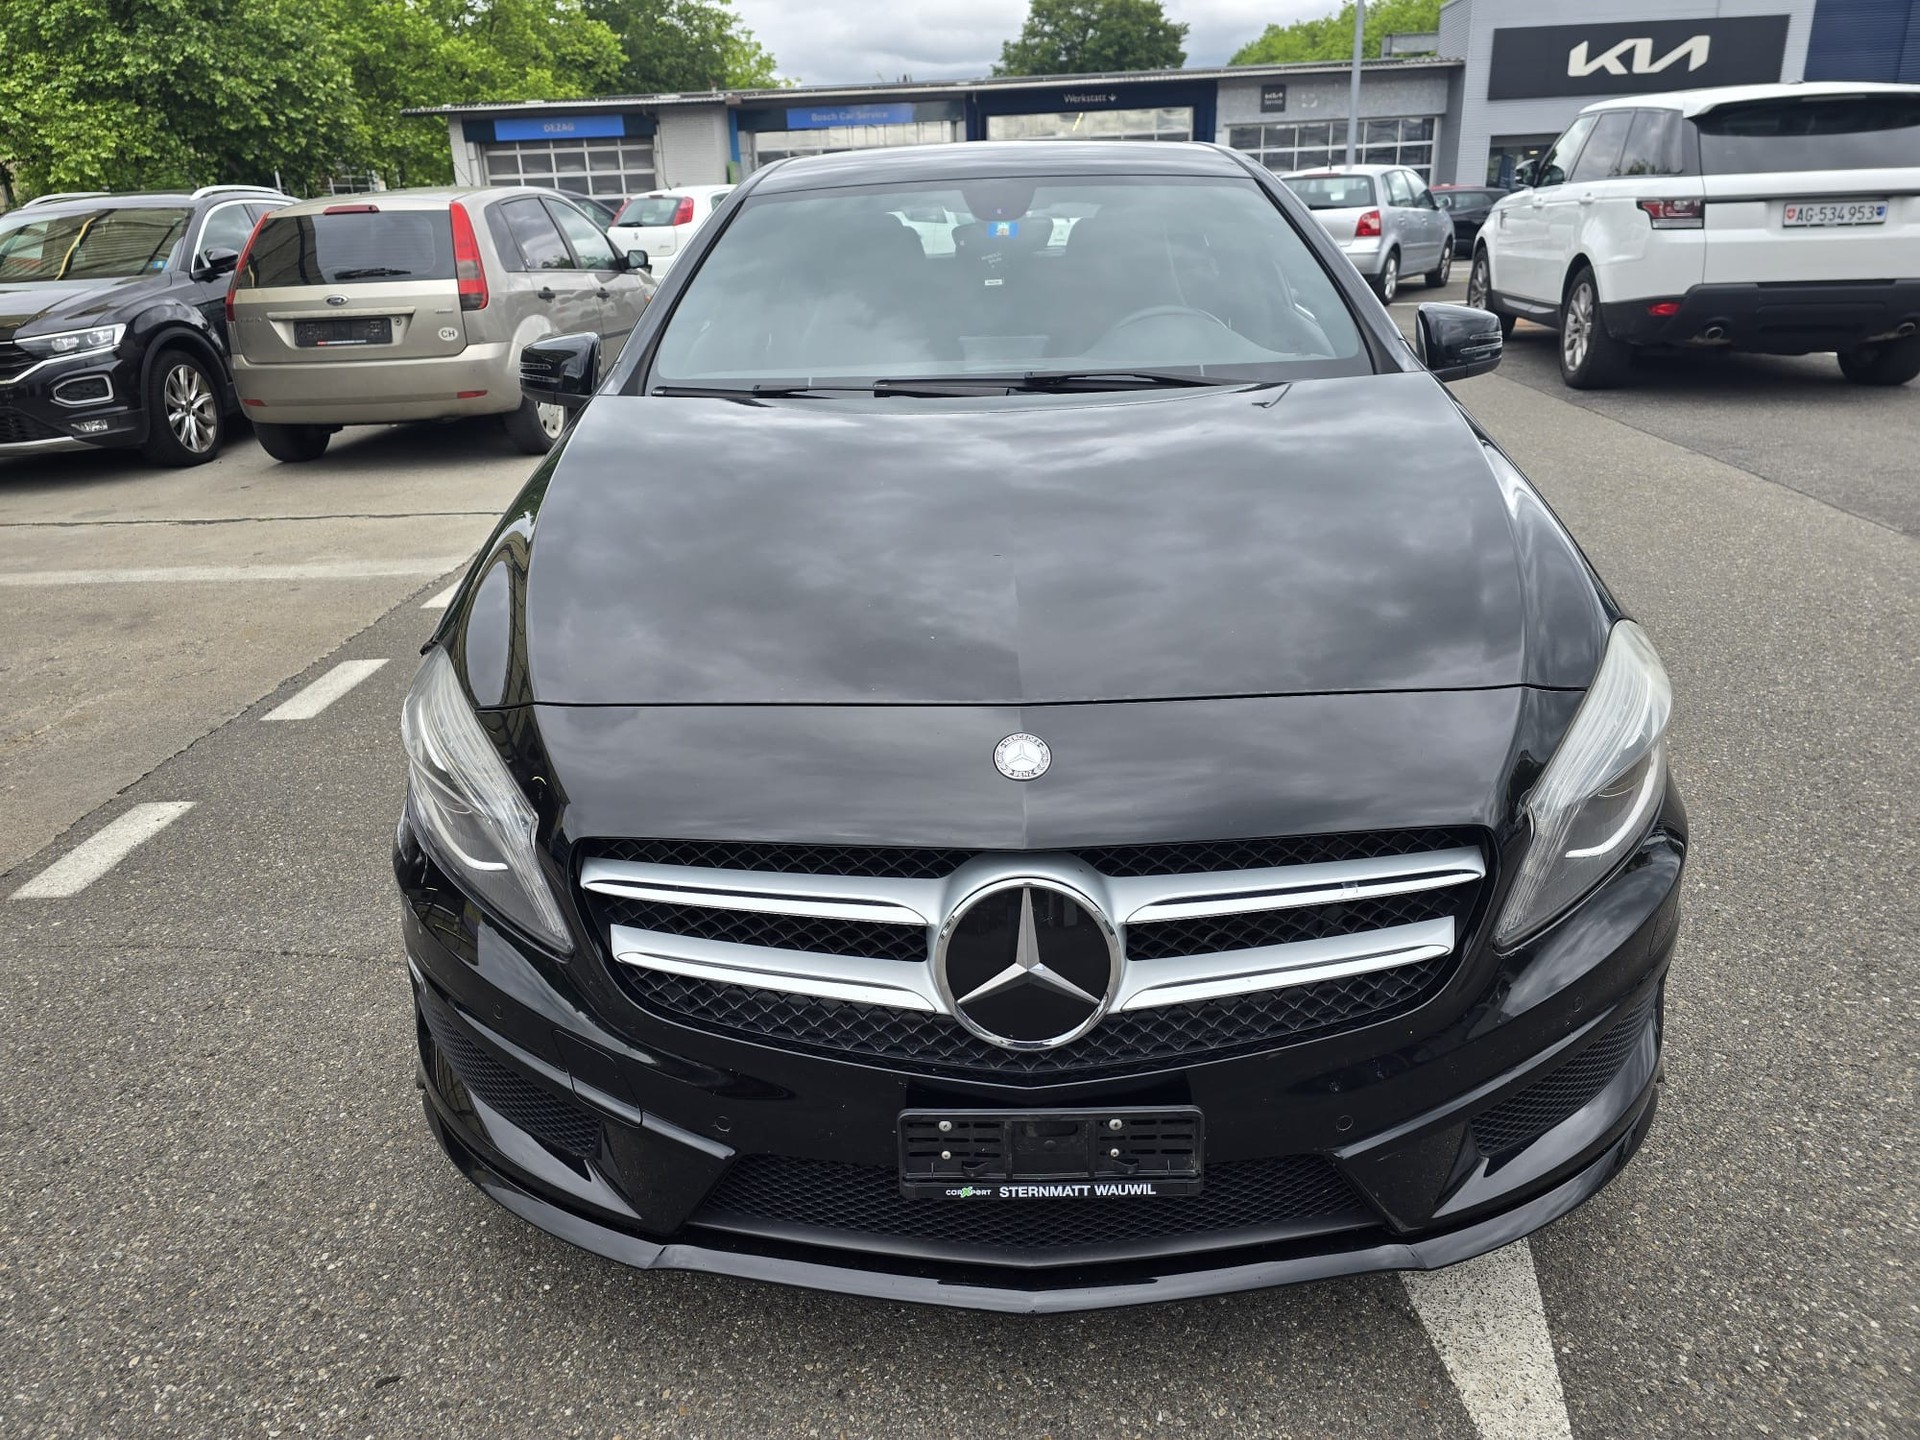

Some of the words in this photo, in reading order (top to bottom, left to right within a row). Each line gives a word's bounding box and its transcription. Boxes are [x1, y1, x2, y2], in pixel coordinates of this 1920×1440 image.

[1567, 35, 1711, 77] KIA
[811, 112, 838, 122] Bosch
[440, 329, 456, 339] CH
[999, 1185, 1091, 1198] STERNMATT
[1094, 1184, 1157, 1196] WAUWIL
